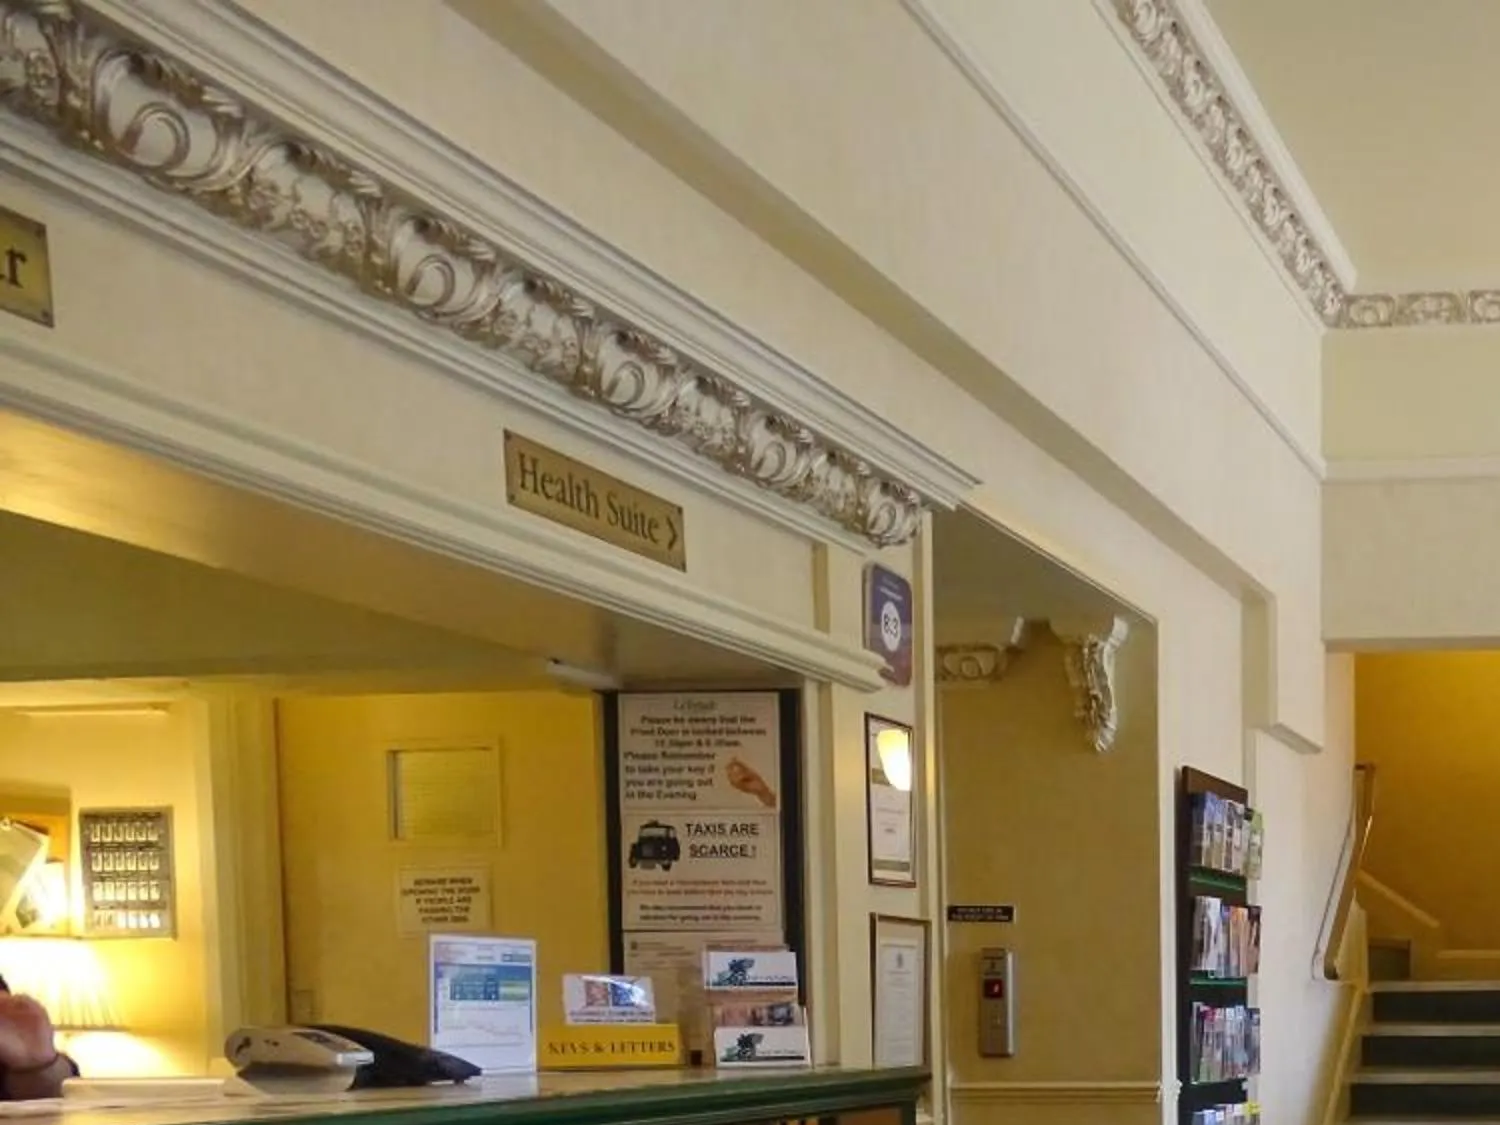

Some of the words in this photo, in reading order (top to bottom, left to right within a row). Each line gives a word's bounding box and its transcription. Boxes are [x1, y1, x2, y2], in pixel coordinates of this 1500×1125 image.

[518, 452, 600, 519] Health
[606, 490, 659, 544] Suite
[686, 823, 727, 836] TAXIS
[729, 822, 760, 836] ARE
[610, 1039, 676, 1053] LETTERS
